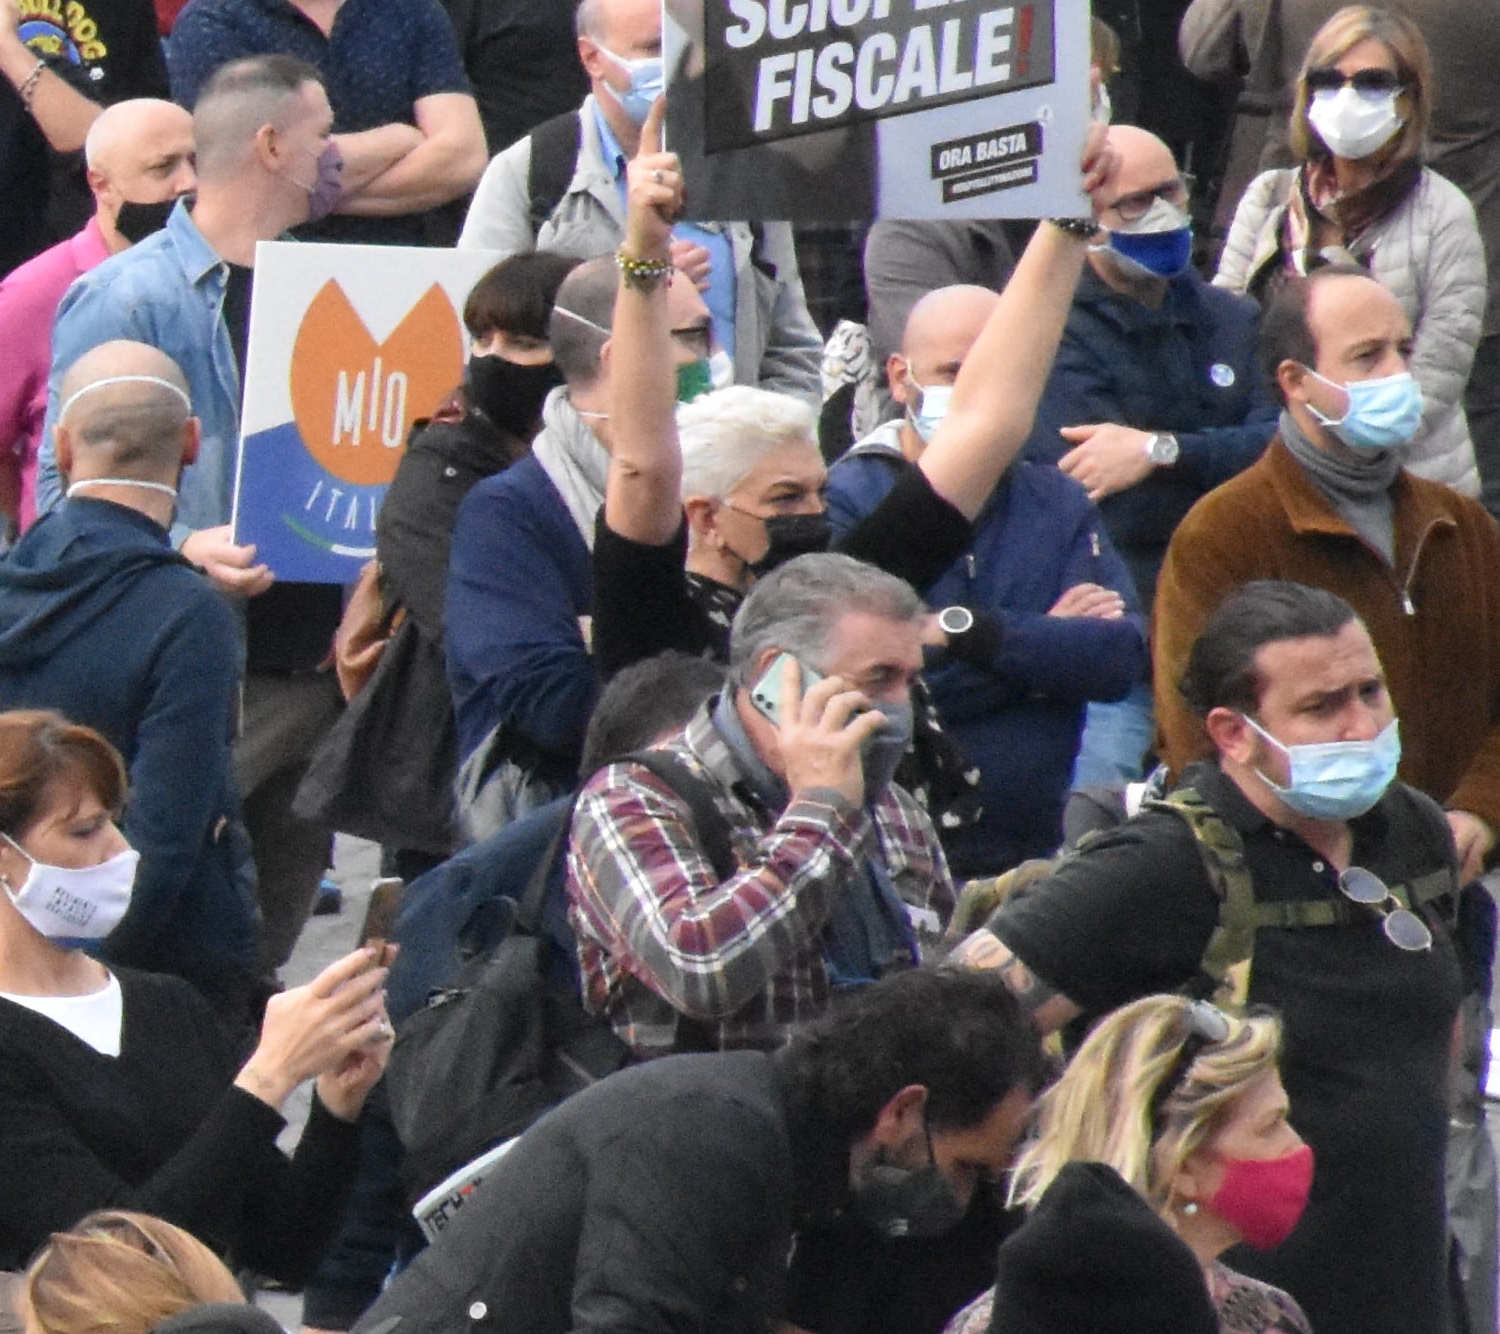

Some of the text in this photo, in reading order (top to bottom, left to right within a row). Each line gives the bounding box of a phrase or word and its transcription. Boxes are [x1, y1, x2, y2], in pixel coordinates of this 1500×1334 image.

[752, 3, 1037, 134] FISCALE!
[939, 132, 1027, 171] ORA BASTA
[333, 356, 409, 449] MIO
